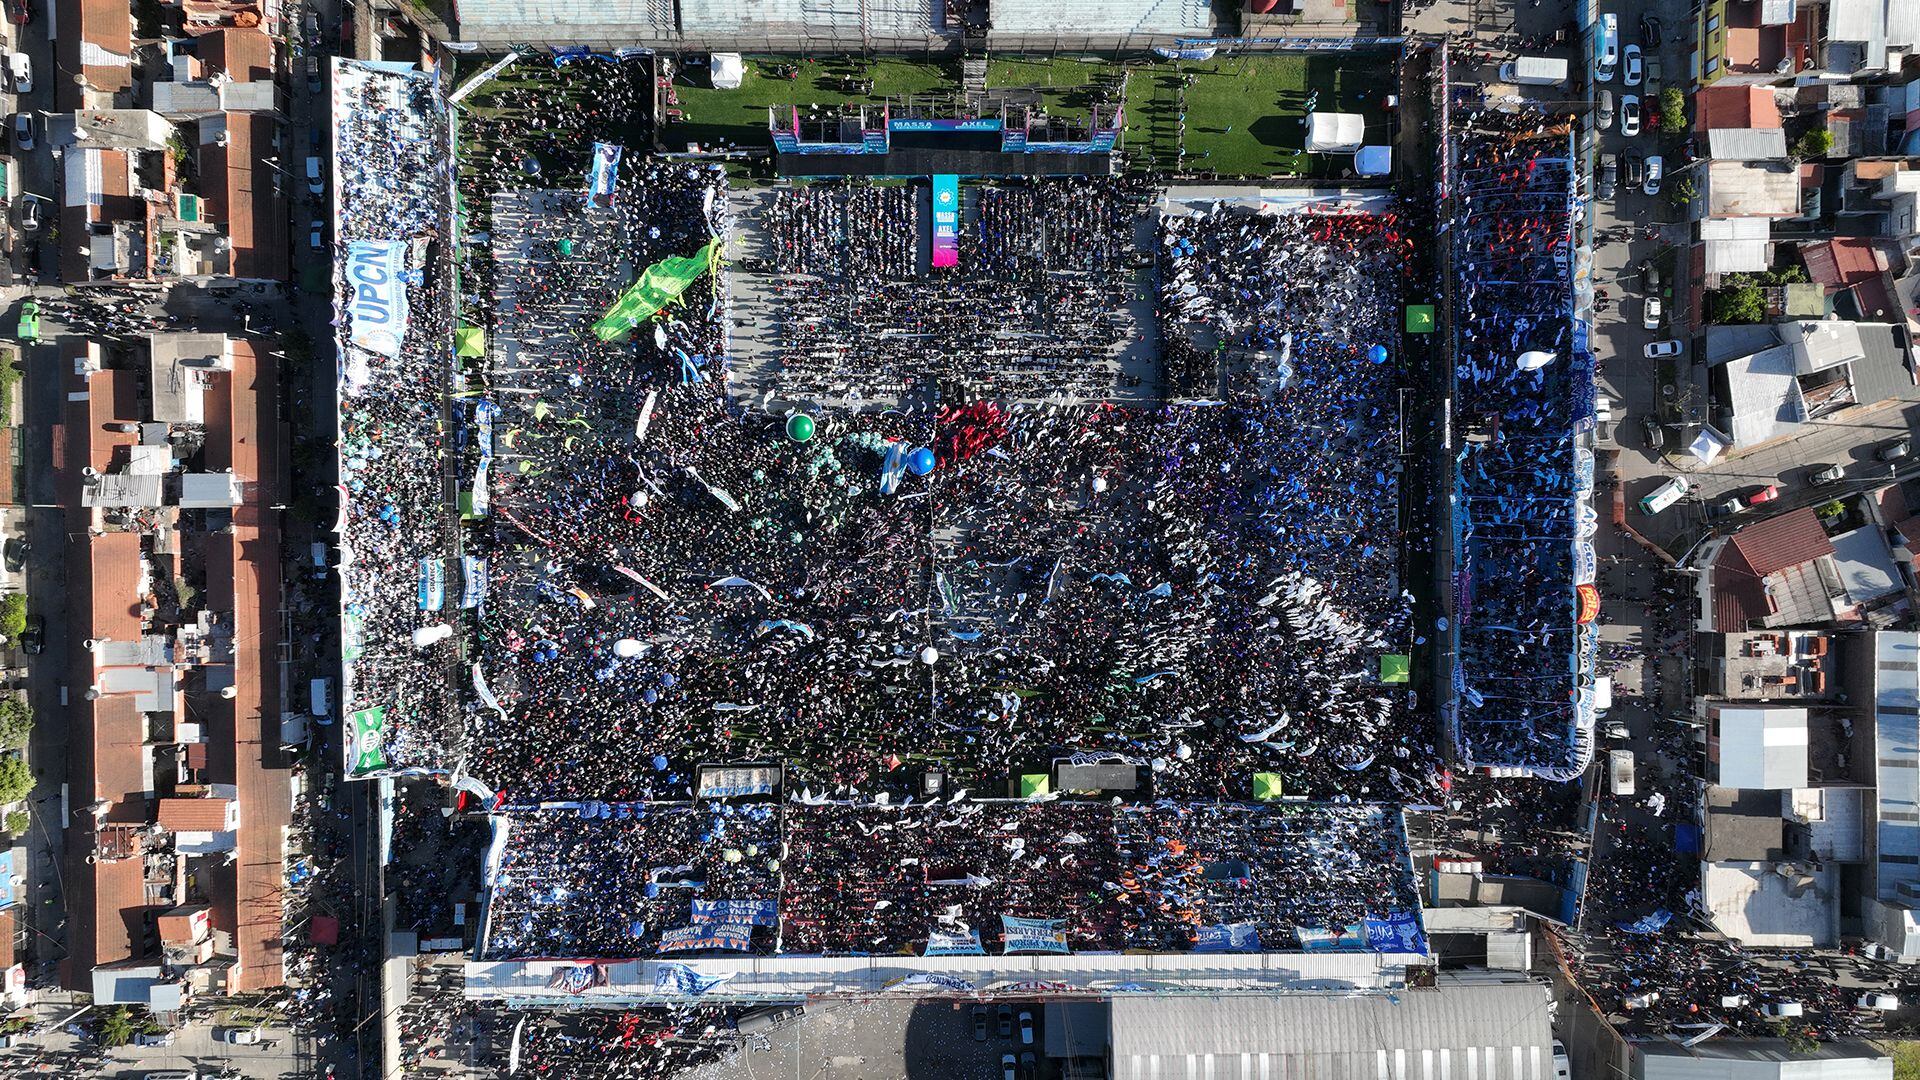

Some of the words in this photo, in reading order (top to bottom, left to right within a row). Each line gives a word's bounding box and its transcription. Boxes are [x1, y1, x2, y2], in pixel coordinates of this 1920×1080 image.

[352, 246, 390, 324] UPCN
[1584, 543, 1594, 572] CCC
[701, 786, 753, 797] MATANZA
[694, 899, 773, 911] ESPINOZA
[712, 908, 757, 916] FERNANDO
[692, 914, 753, 925] MATANZA
[758, 917, 775, 925] LA
[710, 924, 749, 937] ESPINOZA
[1006, 927, 1053, 937] FERRARESI
[658, 937, 725, 952] MATANZA
[729, 938, 748, 951] LA
[1042, 941, 1063, 949] EVA
[926, 975, 964, 990] FERNANDO
